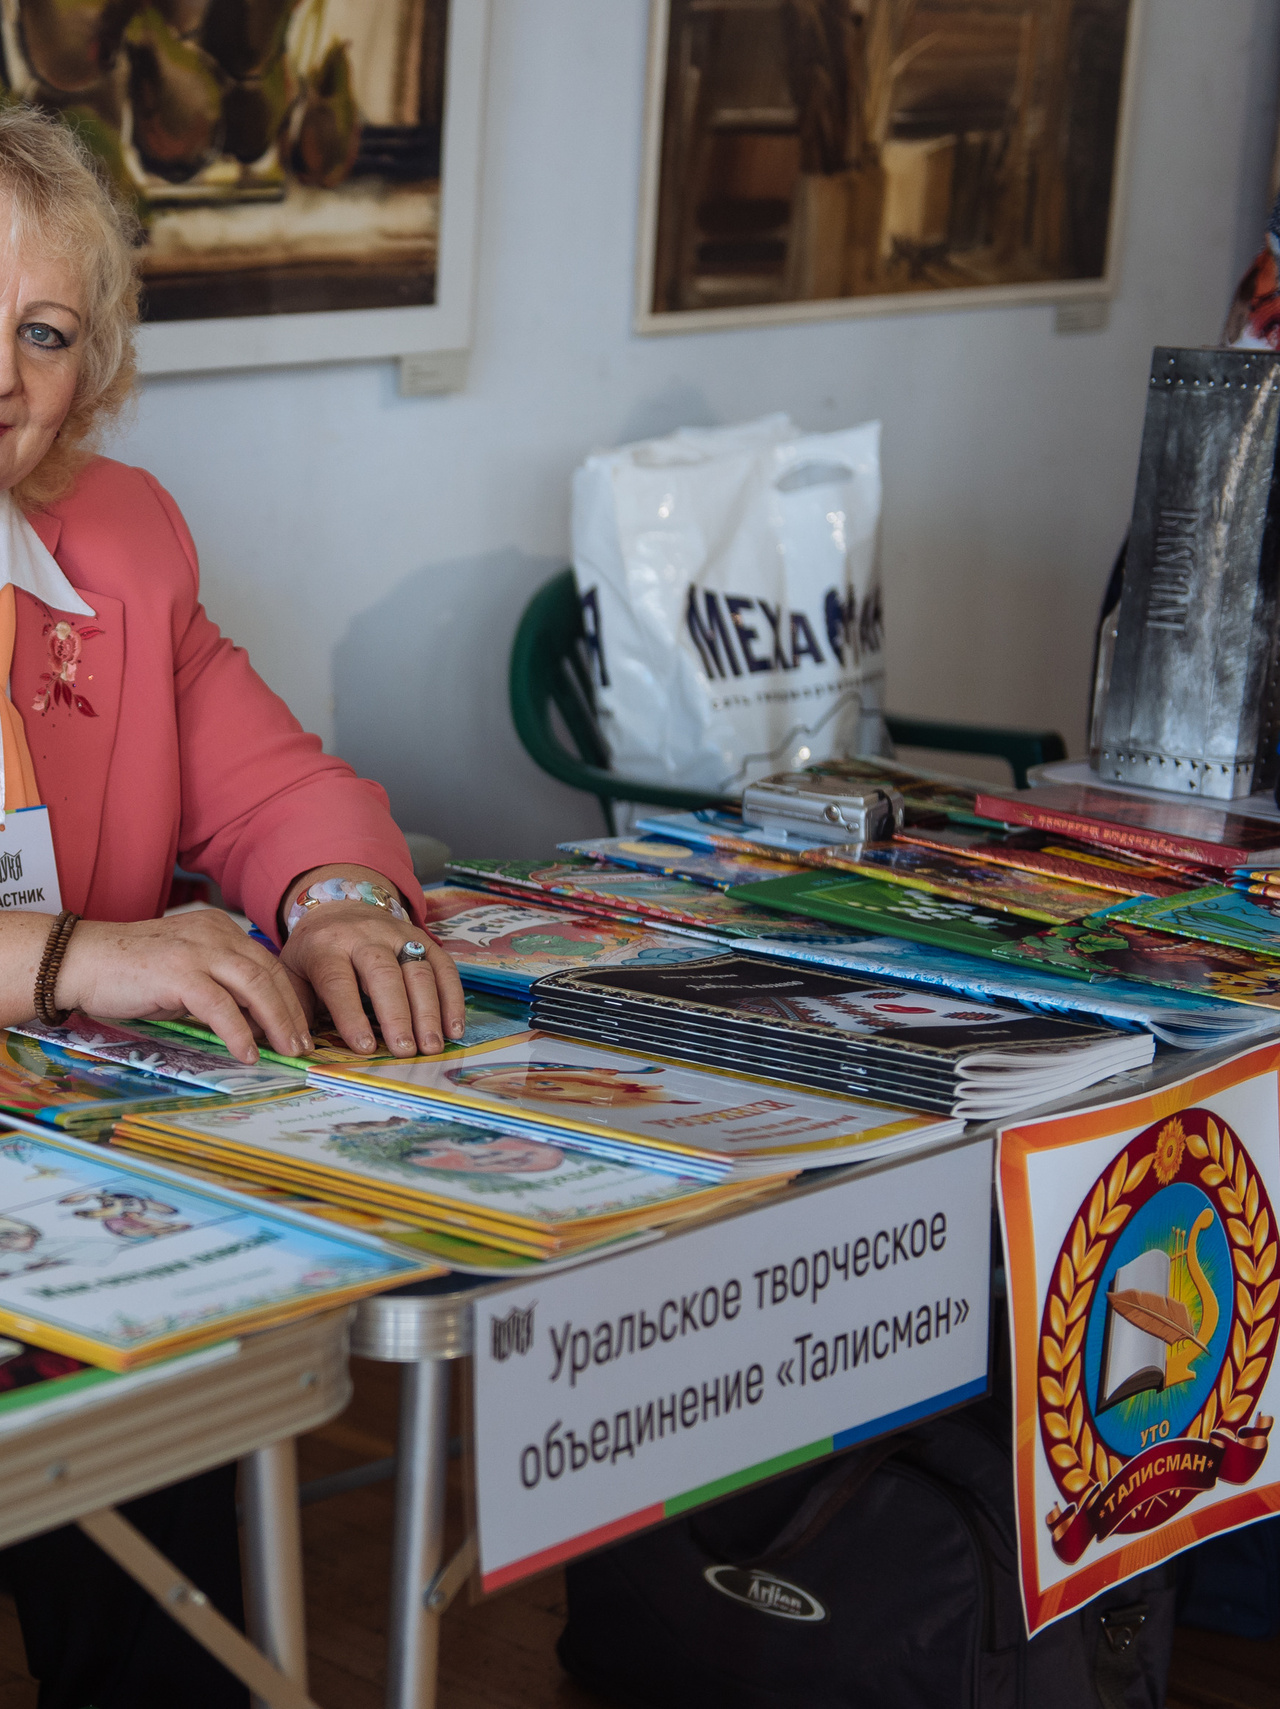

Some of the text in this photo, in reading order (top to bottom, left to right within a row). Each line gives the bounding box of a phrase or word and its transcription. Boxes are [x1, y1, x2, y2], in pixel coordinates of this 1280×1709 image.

[549, 1212, 947, 1388] Уральское творческое
[520, 1297, 970, 1489] объединение «Талисман»
[1140, 1419, 1170, 1448] УТО
[1104, 1453, 1207, 1513] ТАЛИСМАН
